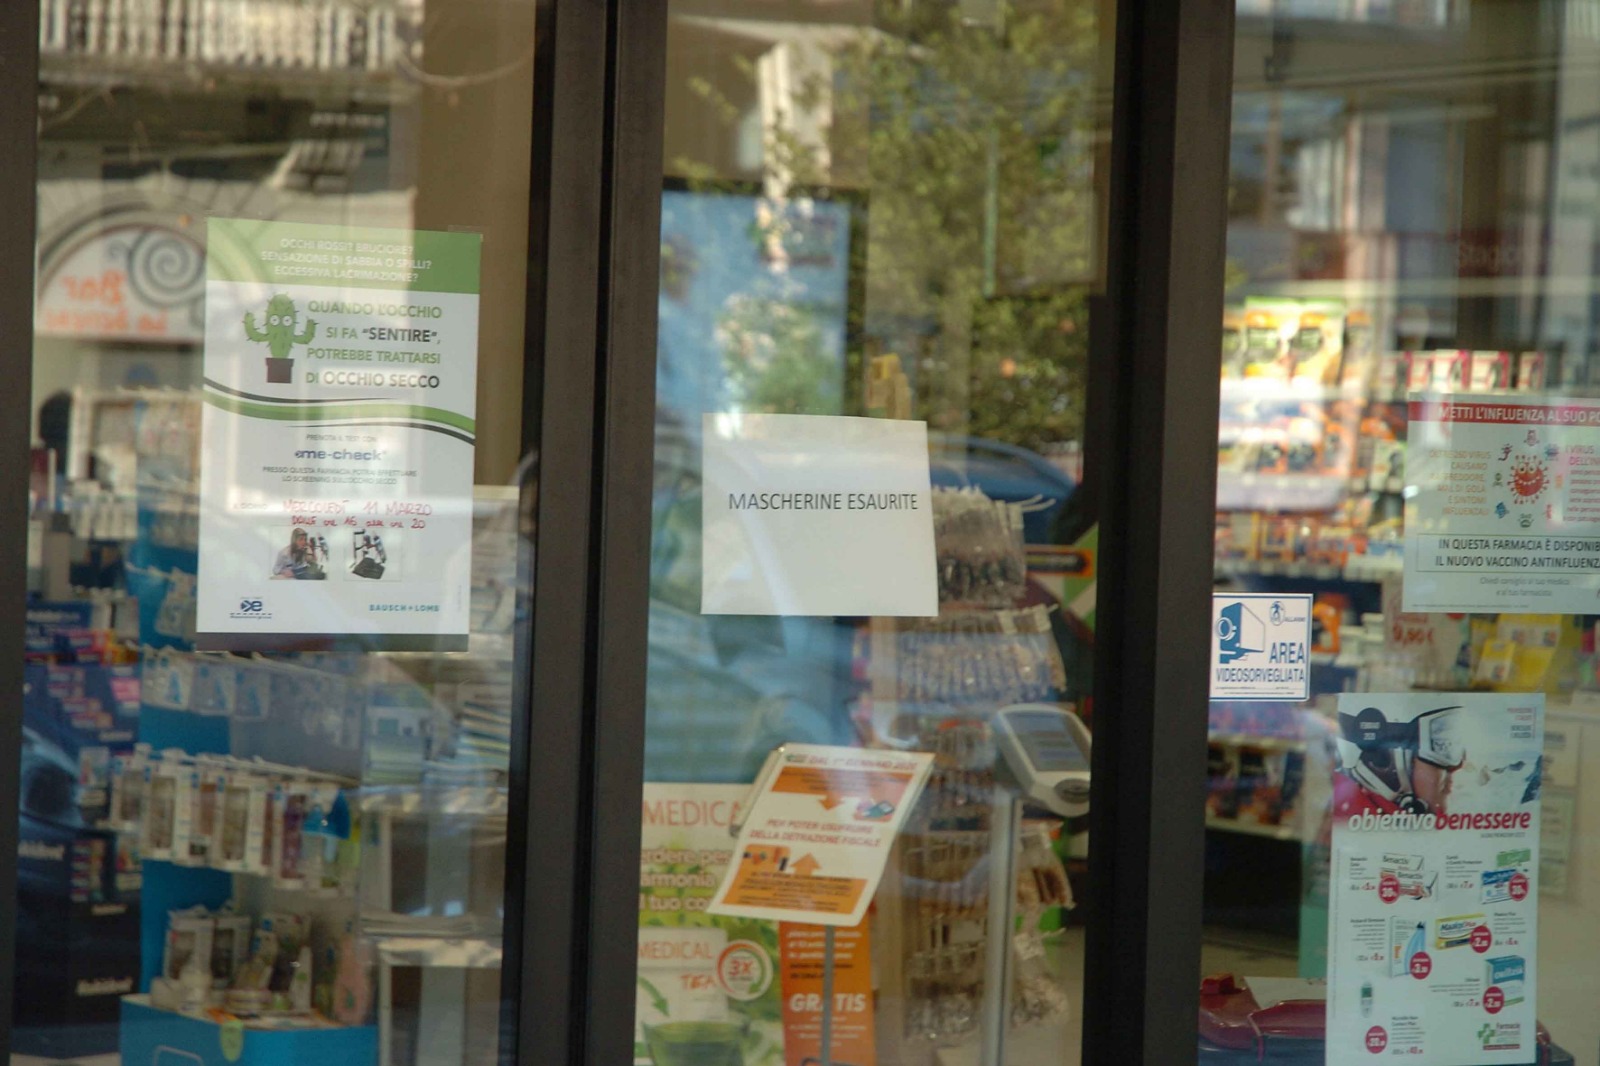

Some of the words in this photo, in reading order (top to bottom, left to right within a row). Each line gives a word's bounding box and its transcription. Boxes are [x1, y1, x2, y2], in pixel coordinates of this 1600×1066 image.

[308, 300, 373, 316] QUANDO
[378, 303, 442, 319] L'OCCHIO
[326, 327, 338, 339] SI
[341, 327, 358, 340] FA
[307, 347, 373, 362] POTREBBE
[377, 351, 441, 364] TRATTARSI
[306, 372, 319, 384] DI
[324, 371, 385, 387] OCCHIO
[389, 373, 439, 389] SECCO
[1438, 406, 1473, 420] METTI
[1476, 407, 1546, 421] L'INFLUENZA
[1548, 409, 1561, 422] AL
[1563, 410, 1586, 423] SUO
[728, 493, 842, 510] MASCHERINE
[847, 493, 918, 510] ESAURITE
[410, 518, 426, 529] 20
[1438, 539, 1450, 549] IN
[1452, 539, 1491, 551] QUESTA
[1493, 539, 1542, 551] FARMACIA
[1545, 538, 1551, 551] È
[1435, 556, 1444, 566] IL
[1446, 556, 1483, 567] NUOVO
[1486, 556, 1528, 568] VACCINO
[1530, 557, 1600, 569] ANTINFLUENZ
[369, 604, 407, 612] BAUSCH
[1269, 642, 1305, 663] AREA
[1216, 668, 1305, 682] VIDEOSORVEGLIATA
[639, 941, 713, 960] MEDICAL
[789, 993, 866, 1012] GRTIS
